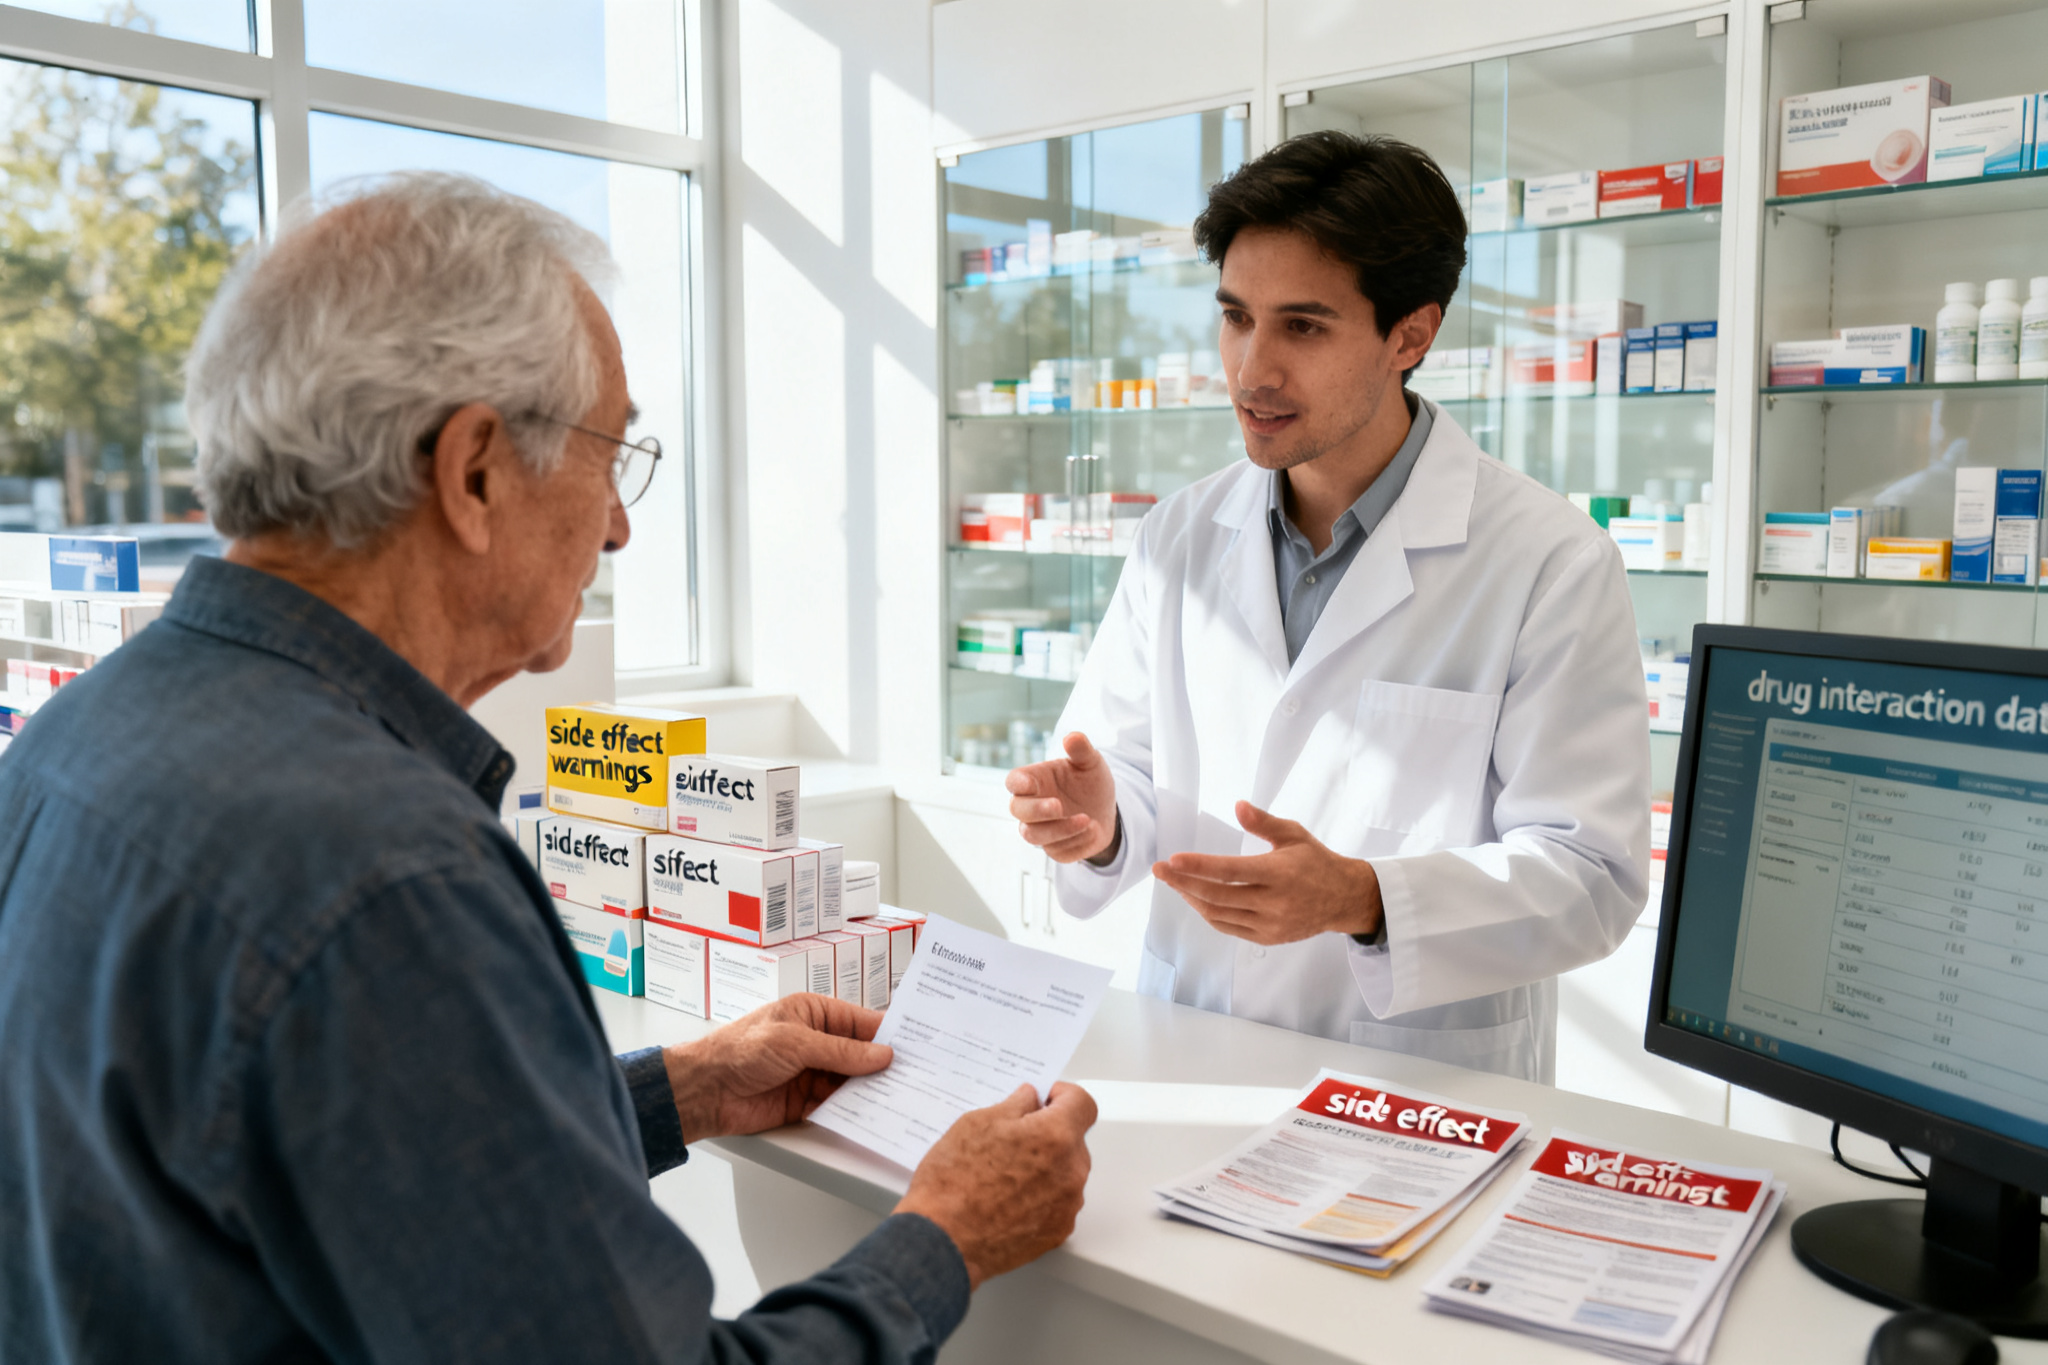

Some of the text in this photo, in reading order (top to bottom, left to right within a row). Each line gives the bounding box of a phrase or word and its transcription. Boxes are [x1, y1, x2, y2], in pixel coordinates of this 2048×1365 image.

[1748, 670, 1812, 715] drug
[1819, 677, 1986, 727] interaction
[550, 717, 595, 748] side
